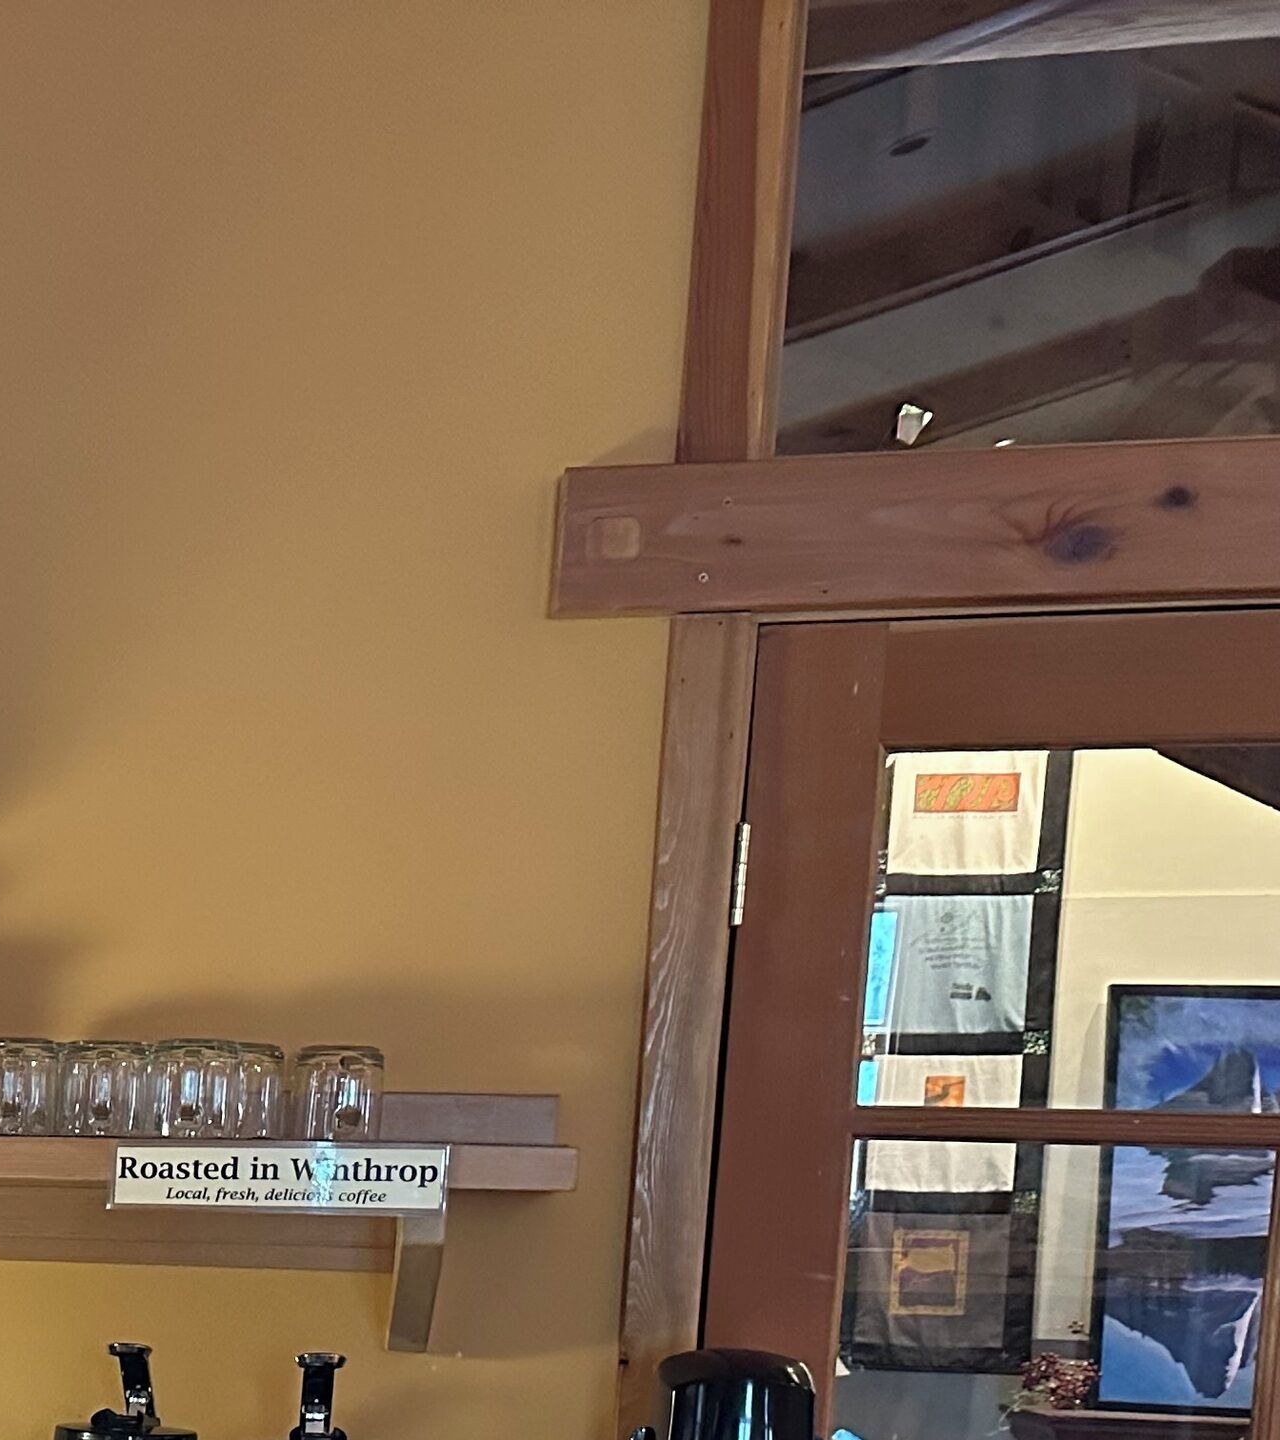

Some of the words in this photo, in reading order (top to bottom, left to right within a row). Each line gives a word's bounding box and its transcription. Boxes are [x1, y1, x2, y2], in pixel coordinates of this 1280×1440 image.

[118, 1156, 240, 1180] Roasted
[249, 1156, 280, 1180] in
[290, 1157, 438, 1188] Wnthrop
[166, 1187, 211, 1202] Local,
[215, 1187, 259, 1202] fresh,
[338, 1188, 387, 1205] coffee
